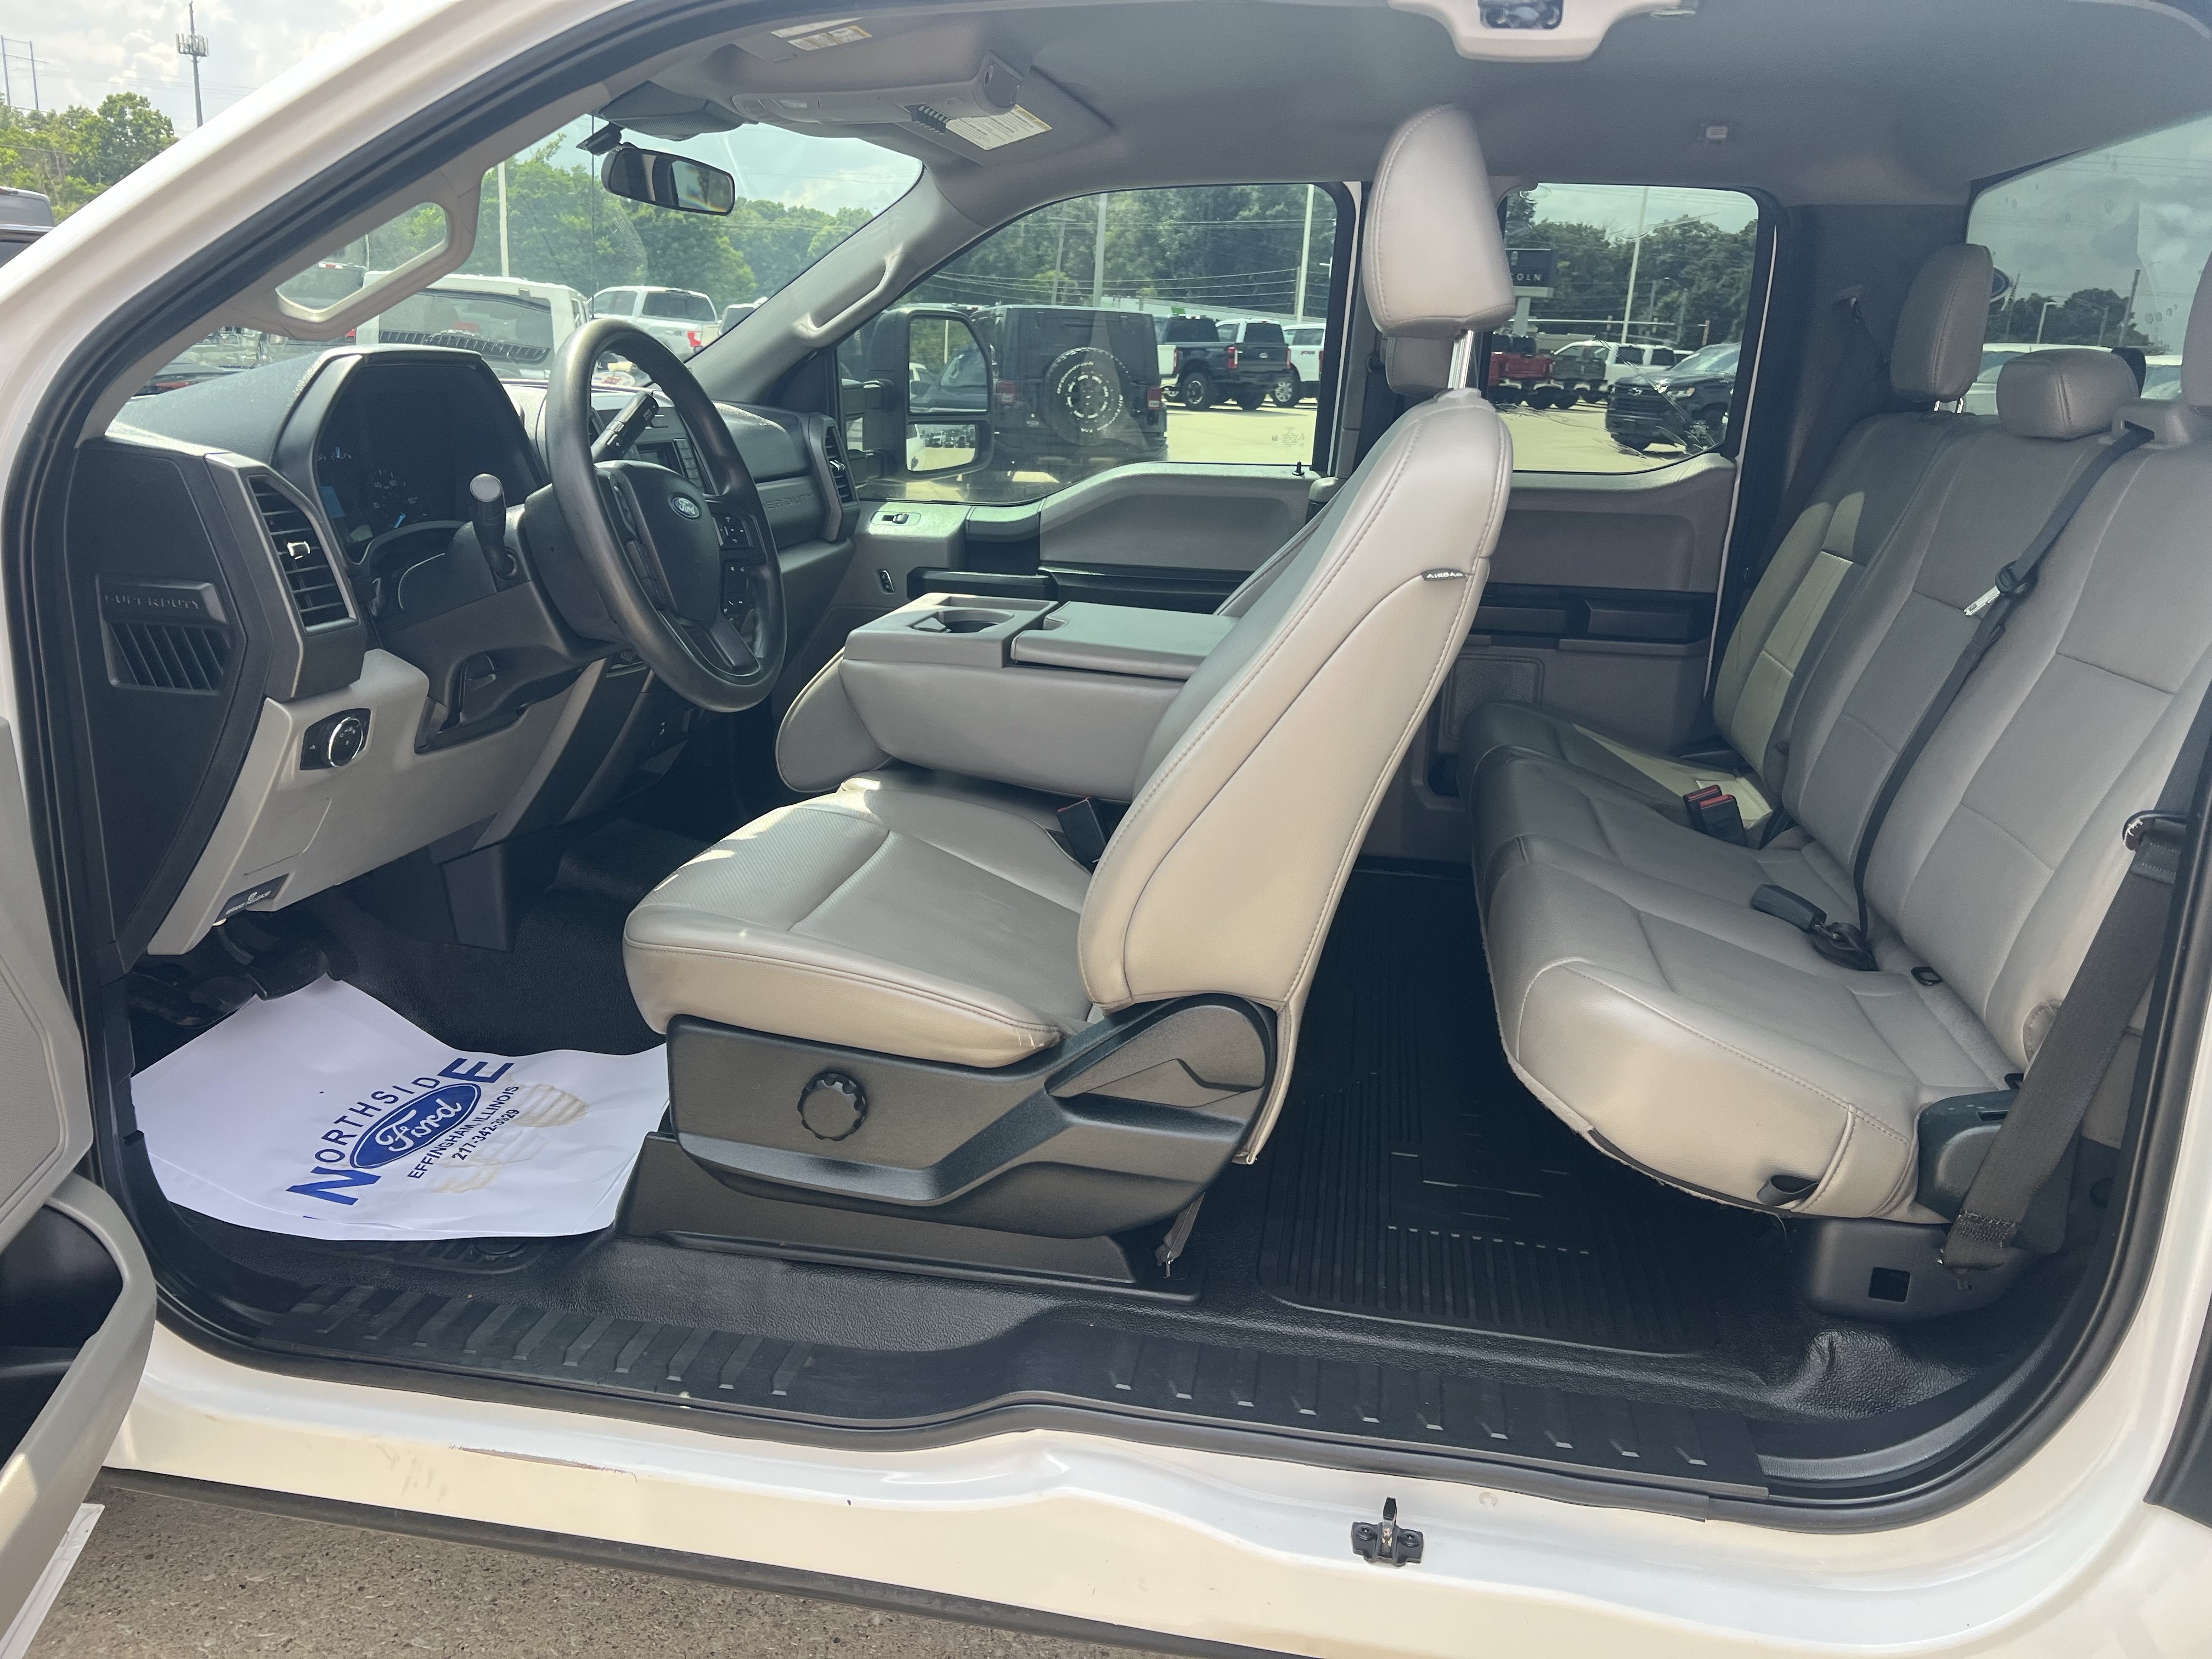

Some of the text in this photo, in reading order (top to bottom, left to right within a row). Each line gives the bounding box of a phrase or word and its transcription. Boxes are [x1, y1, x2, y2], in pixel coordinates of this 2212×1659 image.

[678, 499, 696, 515] Ford
[375, 1097, 462, 1152] Ford
[472, 1086, 520, 1122] ILLINOIS
[285, 1057, 515, 1206] NORTHSIDE
[451, 1109, 520, 1160] 217-342-3929
